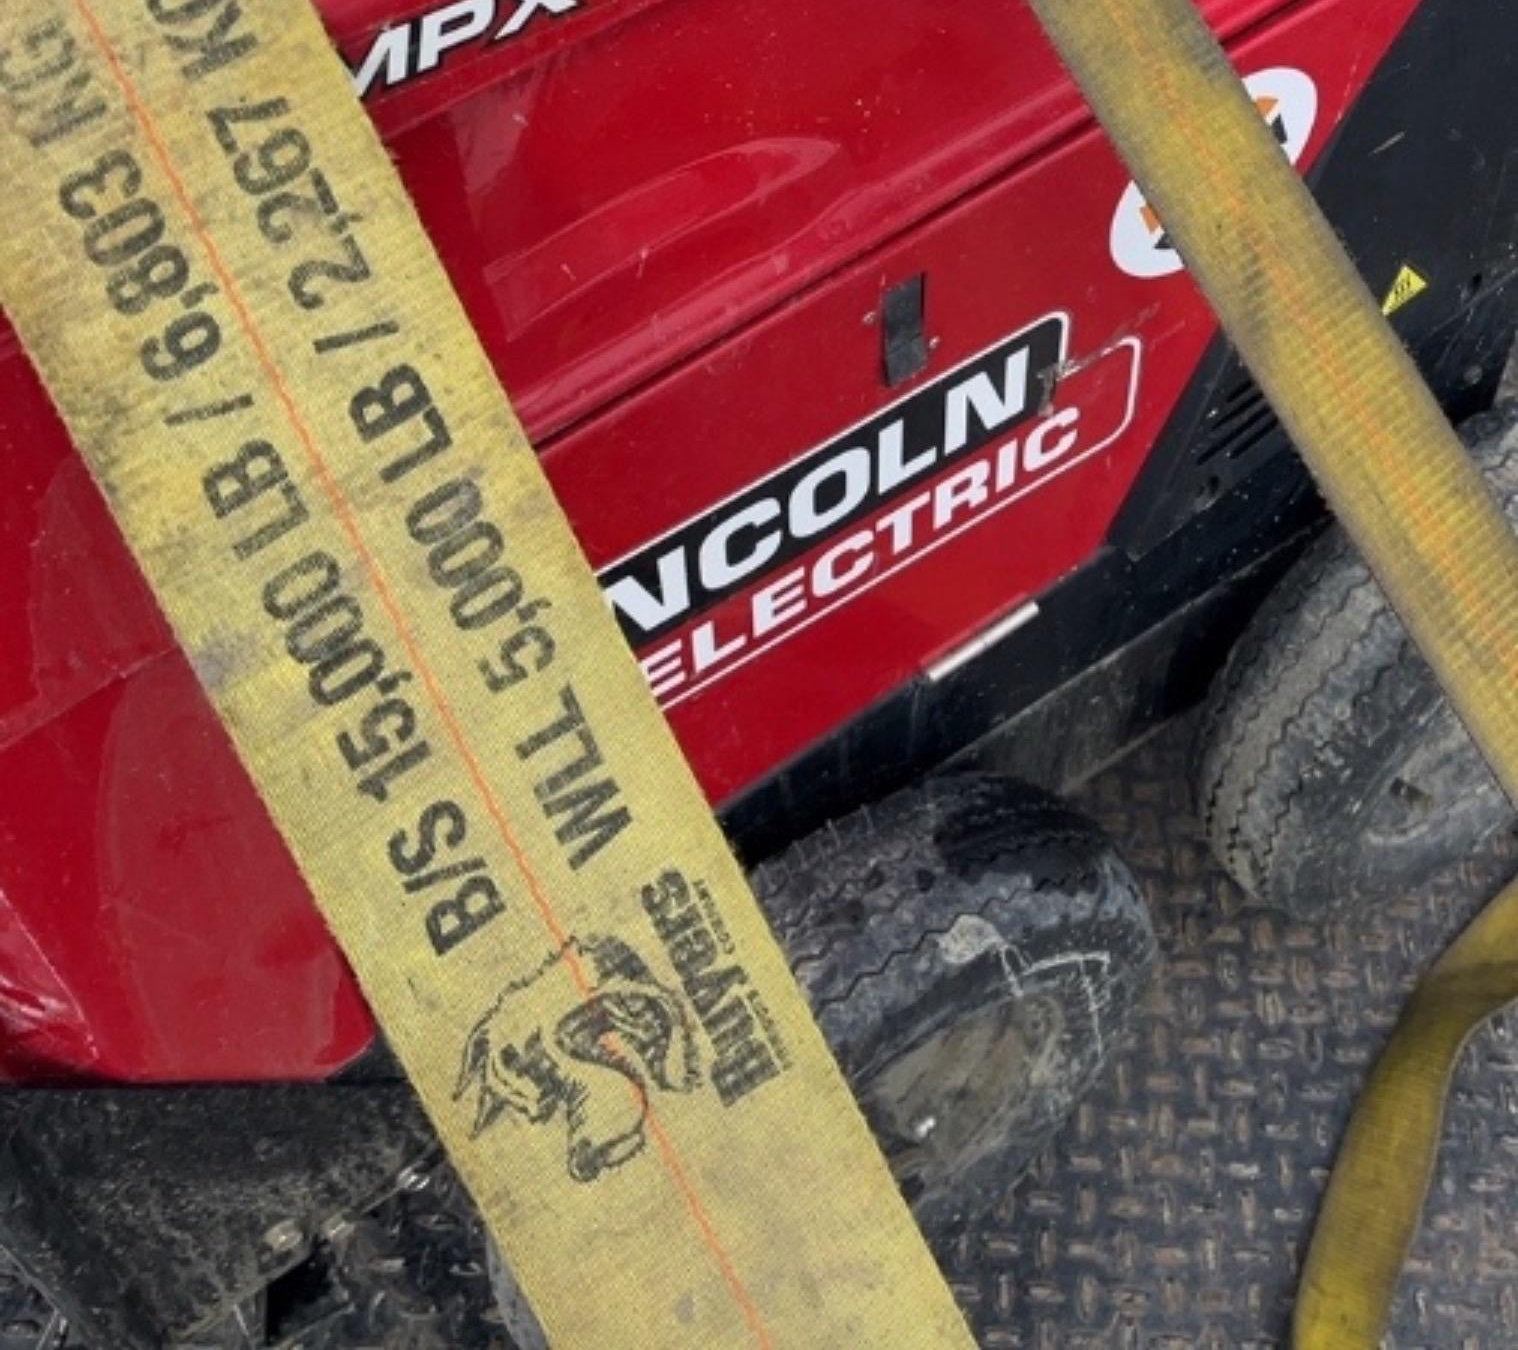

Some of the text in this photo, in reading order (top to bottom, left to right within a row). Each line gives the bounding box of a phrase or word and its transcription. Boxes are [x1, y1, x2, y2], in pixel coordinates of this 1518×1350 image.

[58, 150, 222, 381] 6,803
[206, 96, 372, 311] 2,267
[202, 438, 310, 560] LB
[347, 362, 453, 484] LB
[603, 346, 1029, 632] NCOLN
[404, 475, 557, 693] 5,000
[638, 406, 1081, 698] ELECTRIC
[261, 550, 433, 802] 15,000
[514, 682, 635, 871] WLL
[386, 799, 506, 956] B/S
